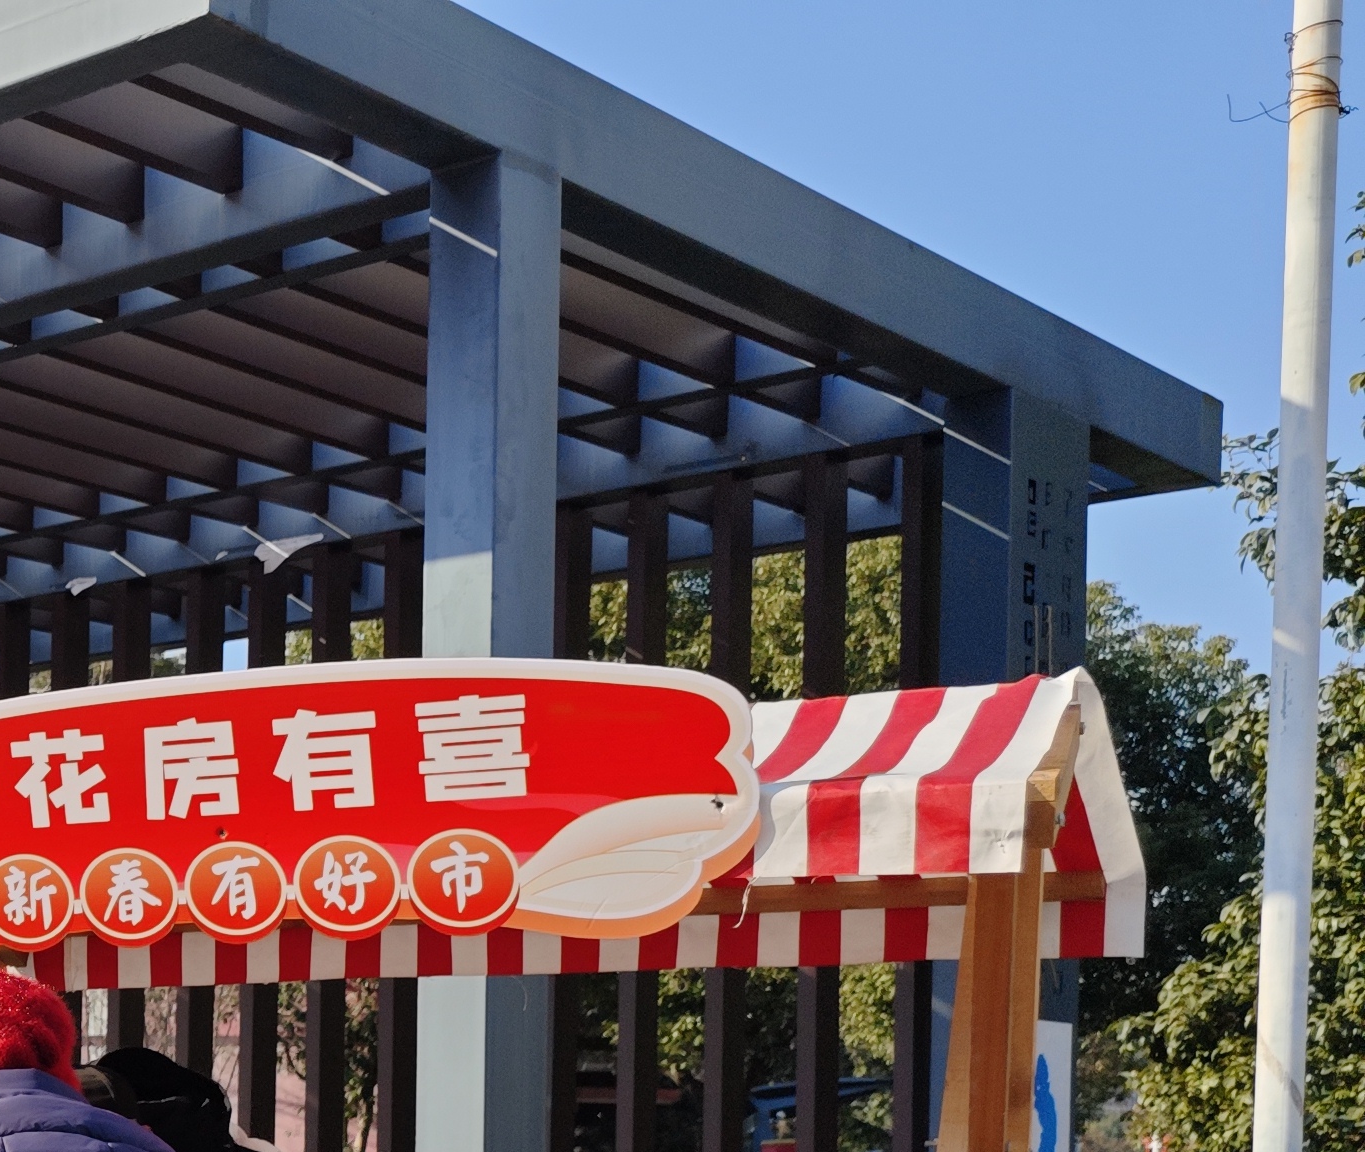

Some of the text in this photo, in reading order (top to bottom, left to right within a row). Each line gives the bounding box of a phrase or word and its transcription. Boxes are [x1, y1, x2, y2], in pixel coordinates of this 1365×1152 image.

[10, 694, 530, 828] 花房有喜
[2, 842, 489, 930] 新春有好市
